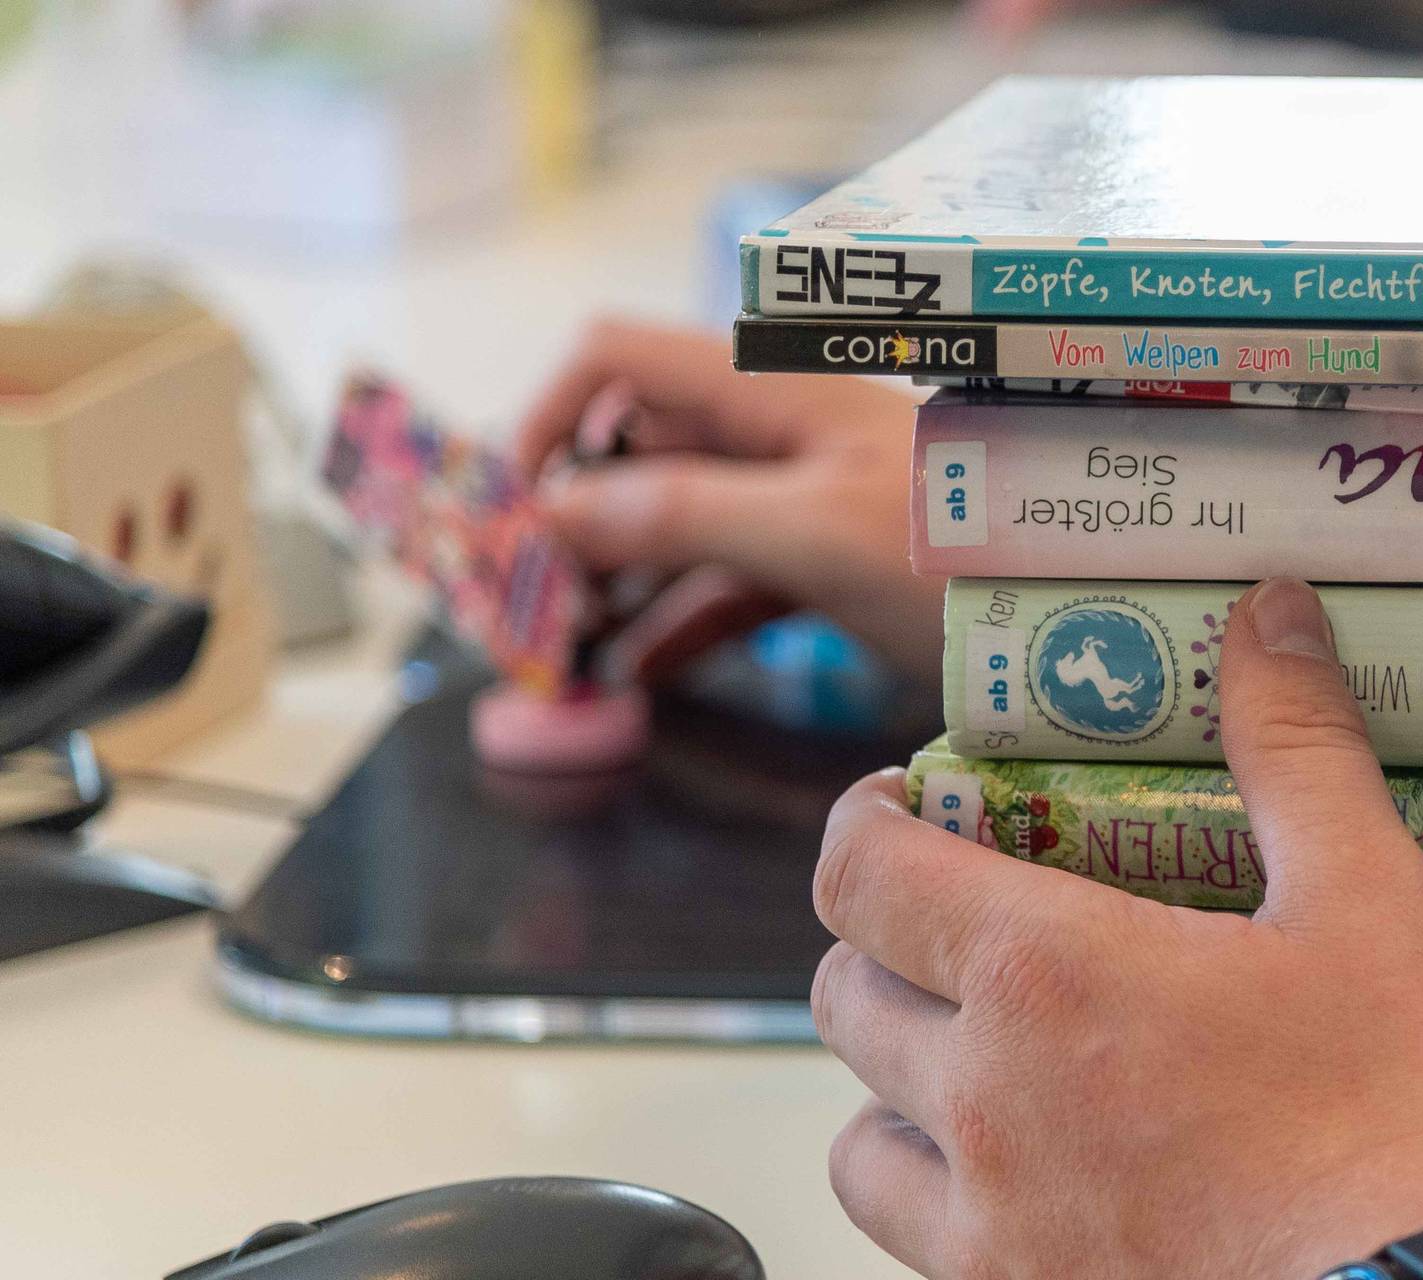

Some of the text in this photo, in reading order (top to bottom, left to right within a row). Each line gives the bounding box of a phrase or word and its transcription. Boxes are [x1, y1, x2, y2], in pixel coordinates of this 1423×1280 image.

[993, 264, 1109, 304] Zöpfe,
[1130, 268, 1273, 307] Knoten,
[1047, 328, 1381, 375] Vom Welpen zum Hund
[1086, 448, 1177, 487] Sieg
[944, 462, 967, 522] ab 9
[1012, 494, 1246, 535] Ihr größter
[988, 653, 1009, 671] 9
[988, 678, 1009, 713] ab
